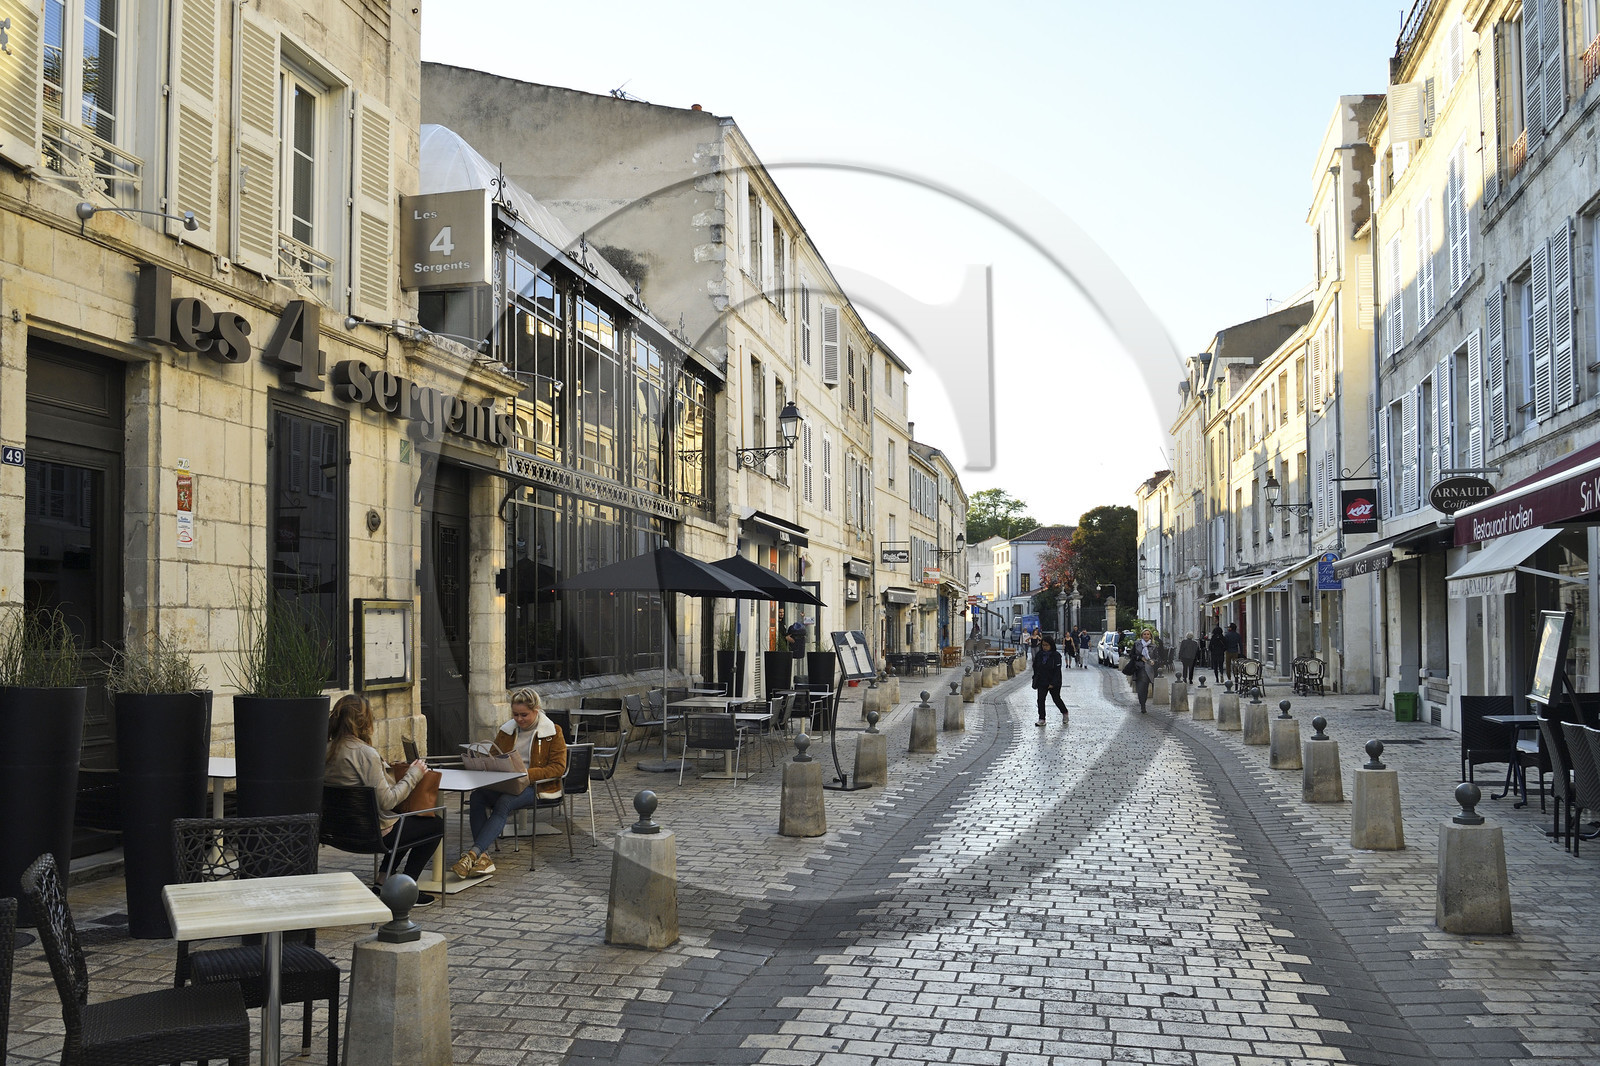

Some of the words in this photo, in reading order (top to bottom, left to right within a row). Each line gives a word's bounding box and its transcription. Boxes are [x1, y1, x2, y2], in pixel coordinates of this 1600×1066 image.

[414, 210, 438, 220] Les
[429, 226, 455, 256] 4
[414, 260, 470, 273] Sergents
[139, 263, 251, 363] les
[262, 301, 326, 392] 4
[334, 360, 513, 449] sergents
[5, 449, 22, 463] 49
[1434, 486, 1490, 498] ARNAULT
[1442, 499, 1478, 509] Coiffe
[1473, 510, 1507, 541] Restaurant
[1508, 504, 1533, 532] indien
[1580, 481, 1592, 512] Sri
[1464, 576, 1494, 595] ARNAULT
